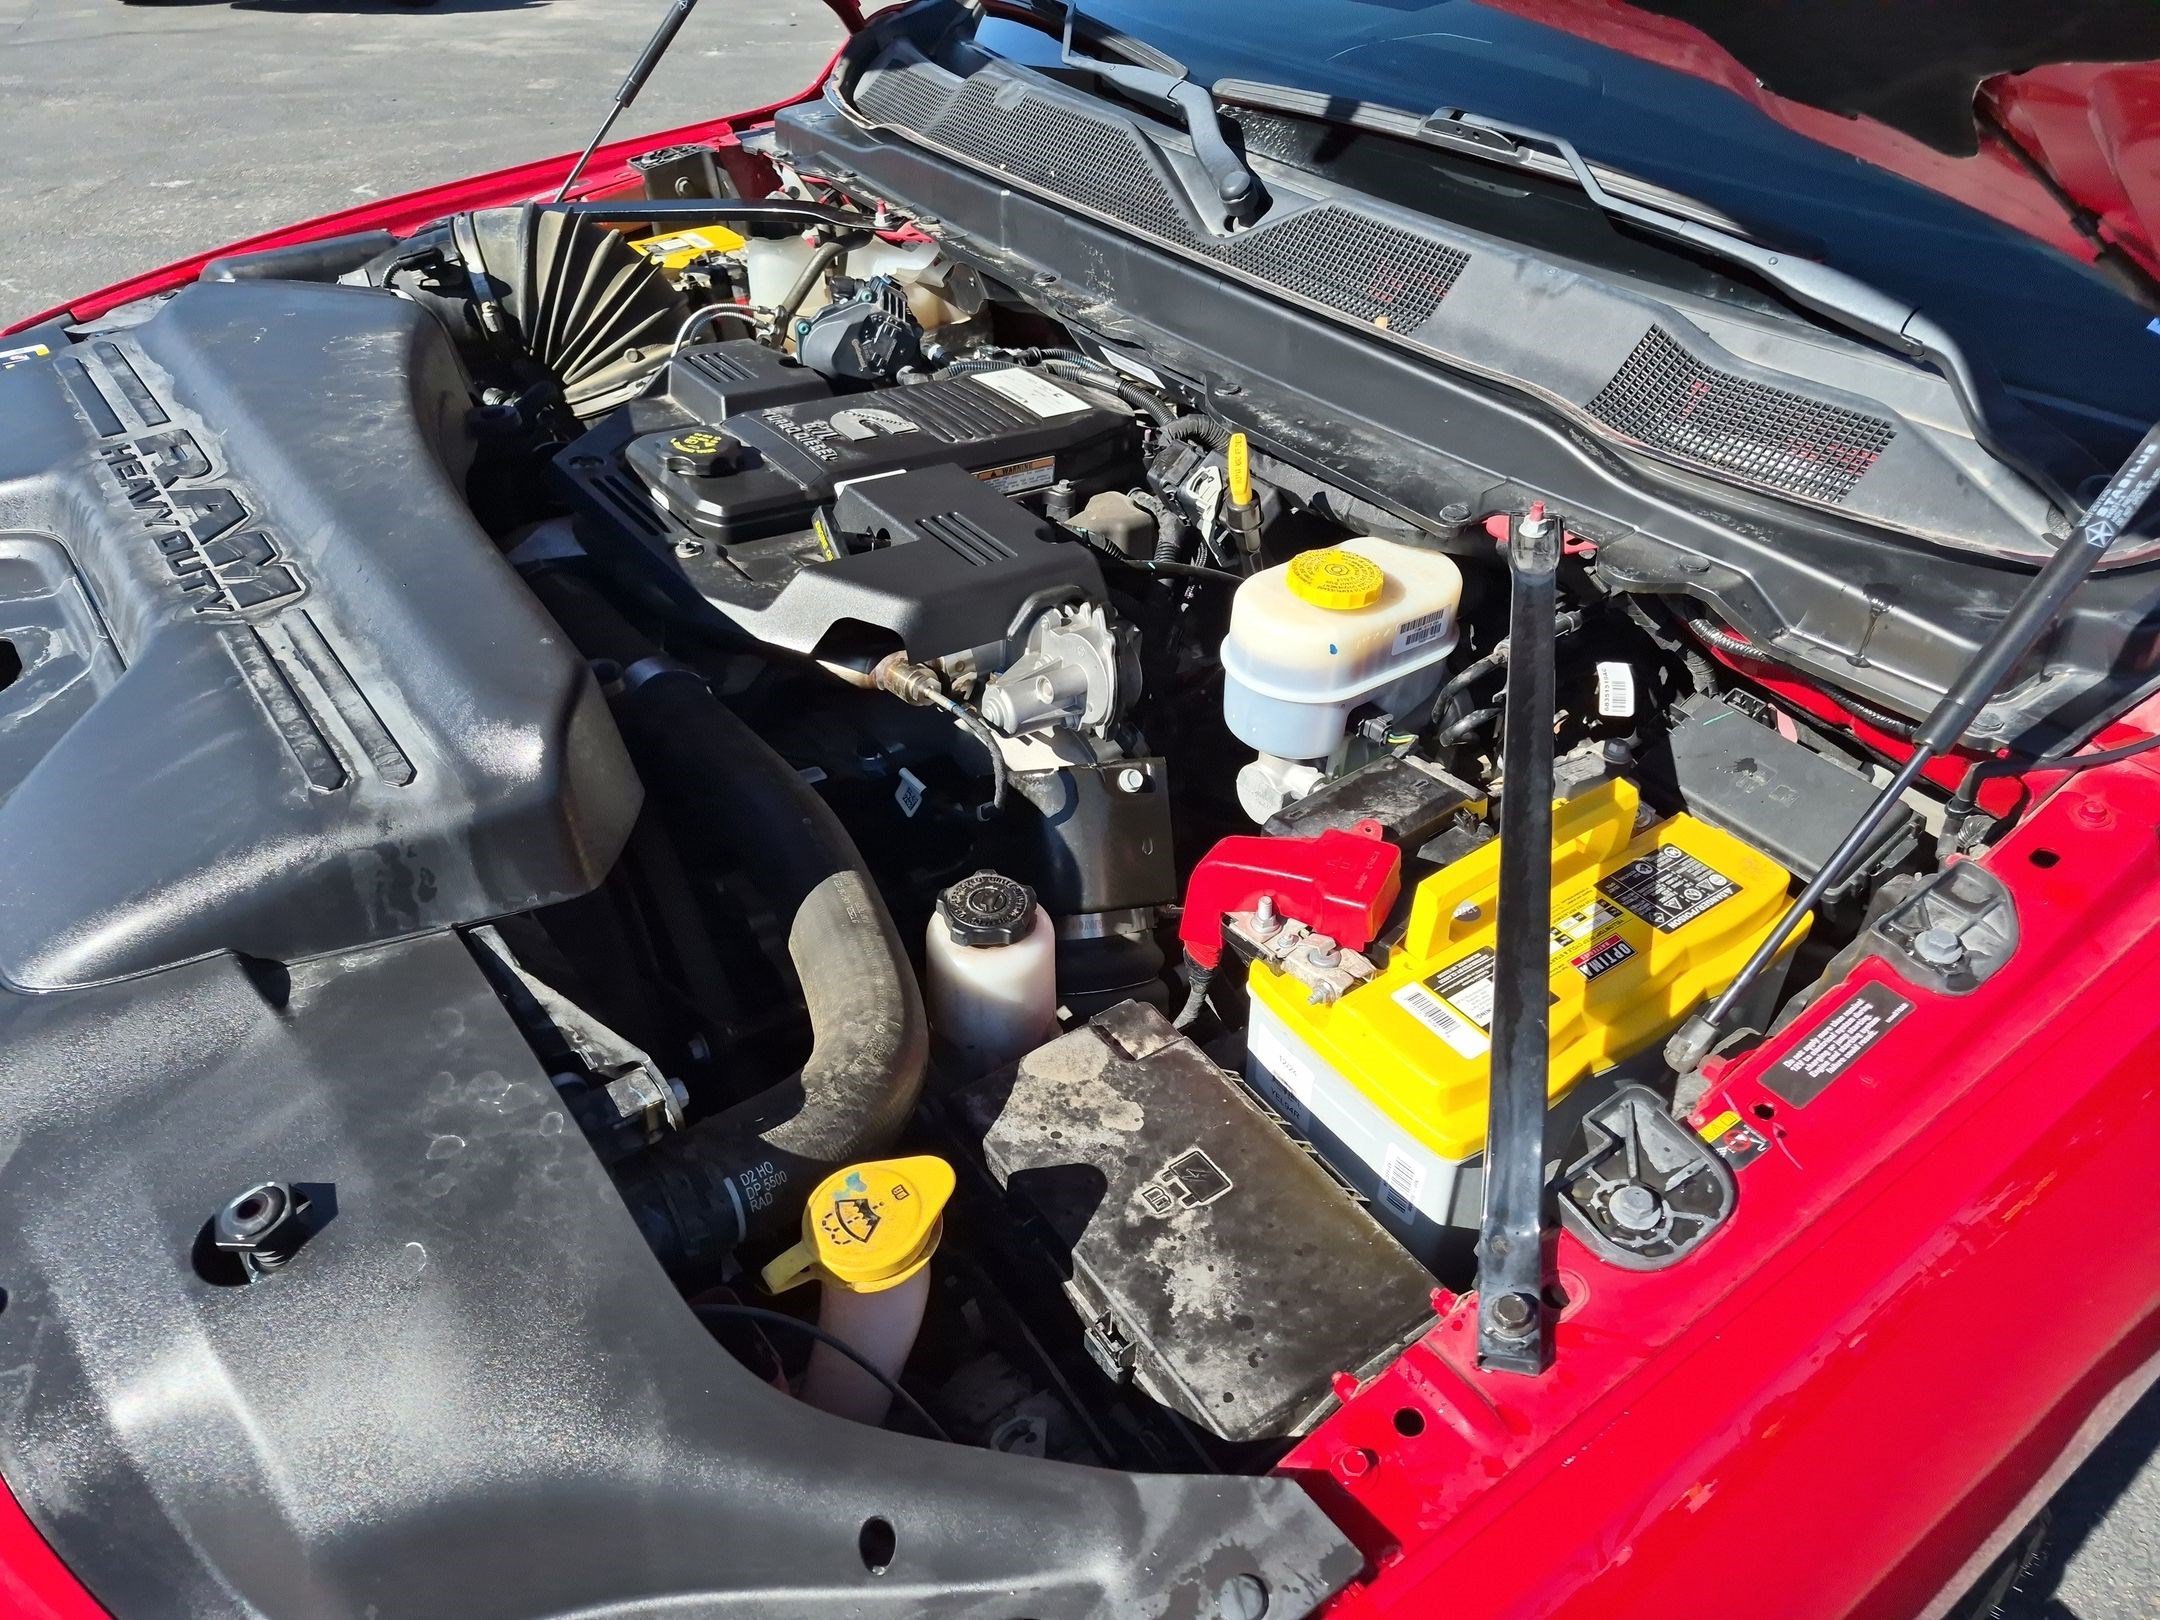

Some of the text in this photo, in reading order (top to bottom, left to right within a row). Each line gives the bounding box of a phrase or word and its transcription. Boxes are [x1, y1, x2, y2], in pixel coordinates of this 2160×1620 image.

[2096, 444, 2158, 517] STABILUS
[99, 442, 235, 614] HEAVY DUTY
[134, 429, 303, 609] RAM
[1666, 890, 1729, 929] DANGER/POISON
[1578, 941, 1632, 977] OPTIMA
[1783, 1058, 1795, 1067] Do
[1792, 1049, 1805, 1060] not
[1802, 1037, 1820, 1052] apply
[1817, 1026, 1833, 1039] more
[1829, 1015, 1846, 1027] than
[1802, 1054, 1812, 1062] to
[1808, 1032, 1837, 1056] electrical
[1834, 1016, 1857, 1035] system
[1852, 1002, 1873, 1019] during
[1804, 1049, 1831, 1071] charging
[1827, 1043, 1837, 1051] or
[1833, 1032, 1851, 1046] jump
[1809, 1015, 1882, 1078] Engine and starting system
[1825, 1056, 1846, 1073] failure
[1843, 1044, 1861, 1058] could
[740, 1170, 757, 1186] D2
[746, 1170, 788, 1201] DP 5500
[750, 1192, 773, 1213] RAD
